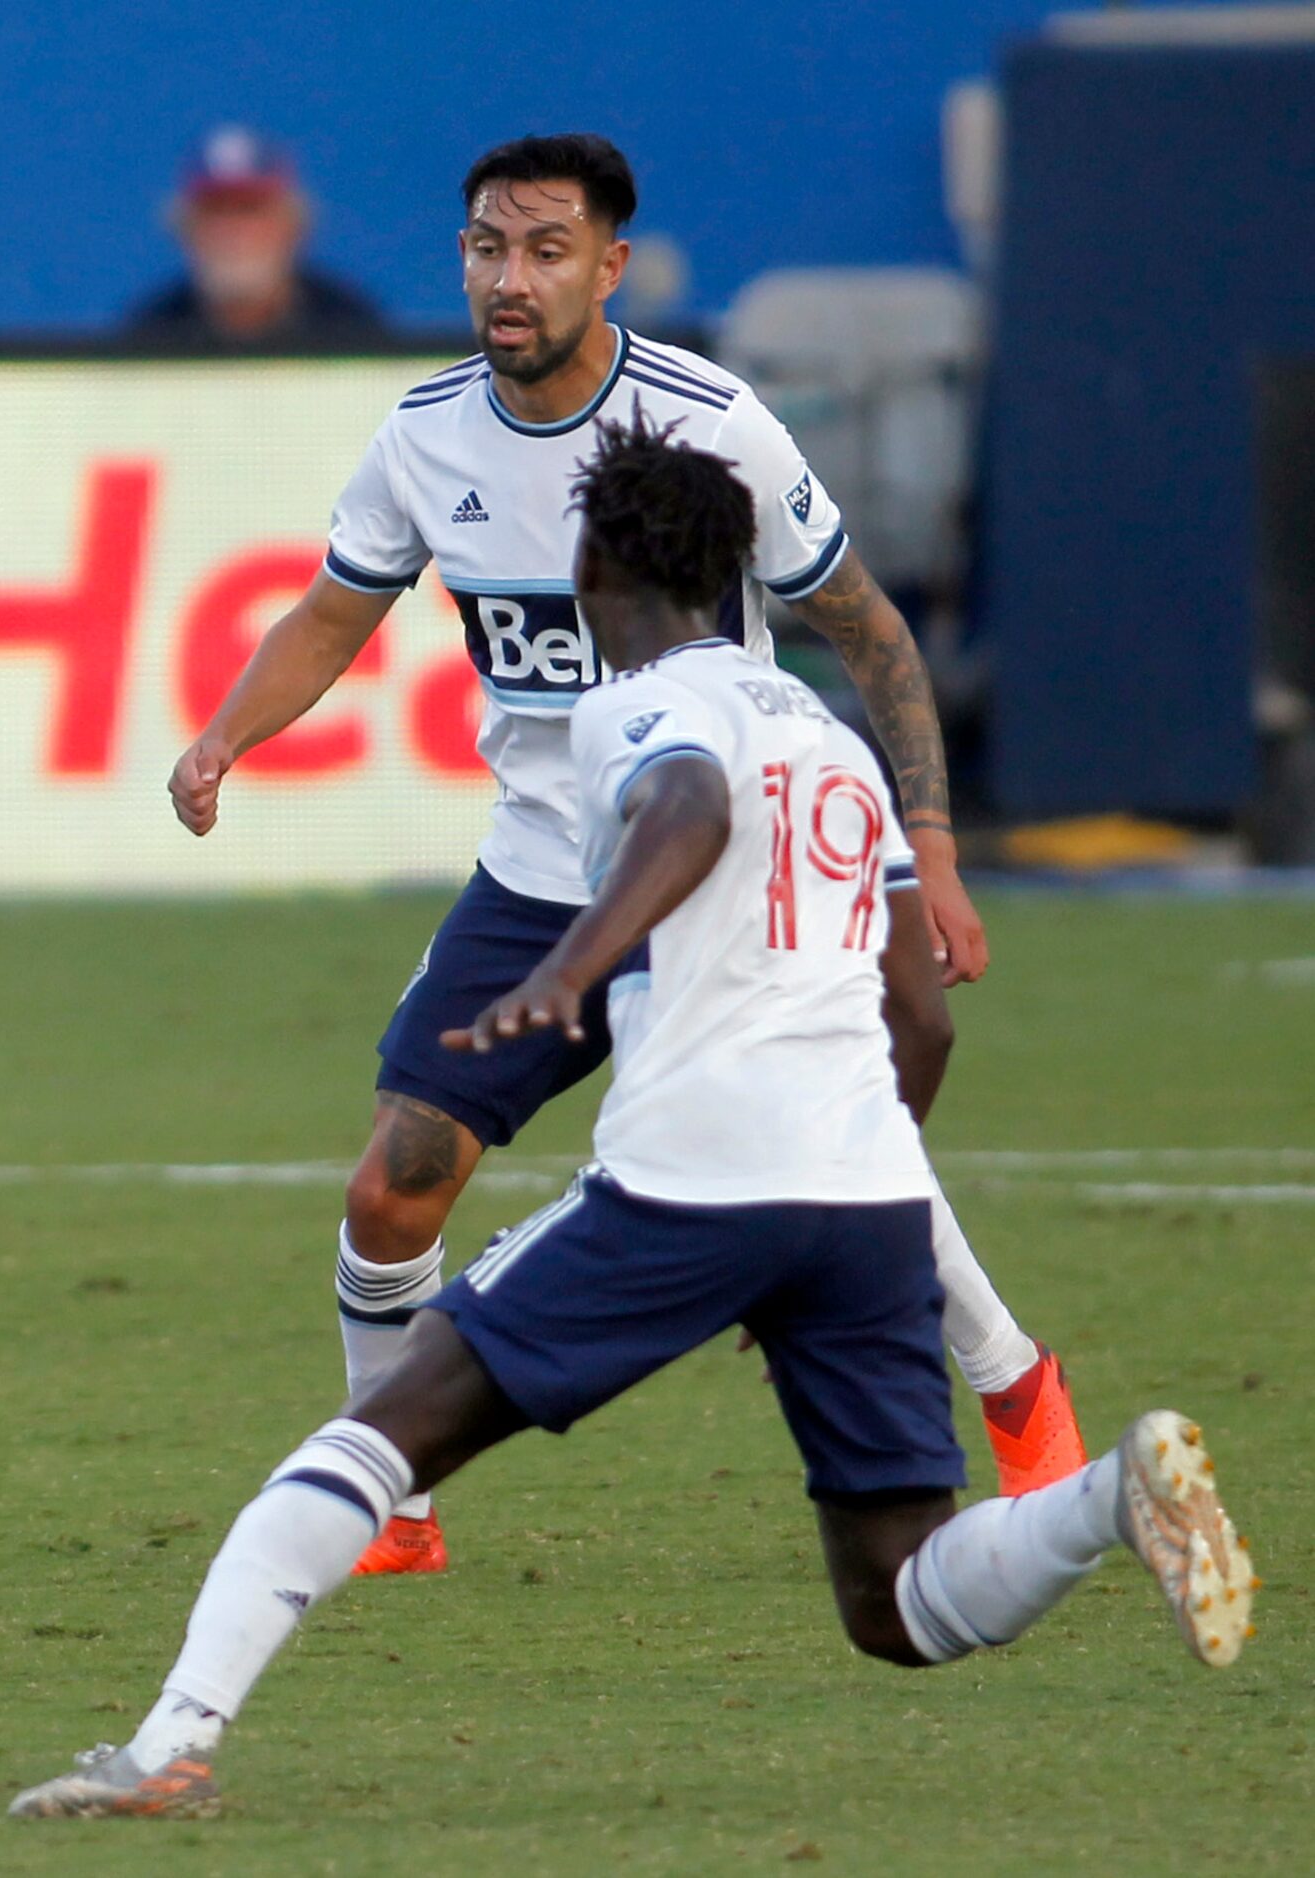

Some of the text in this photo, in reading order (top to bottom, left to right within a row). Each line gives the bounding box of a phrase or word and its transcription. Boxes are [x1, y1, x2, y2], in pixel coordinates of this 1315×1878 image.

[451, 509, 489, 523] adidas
[788, 481, 809, 506] MLS
[477, 596, 613, 685] Bel
[762, 763, 883, 951] 19
